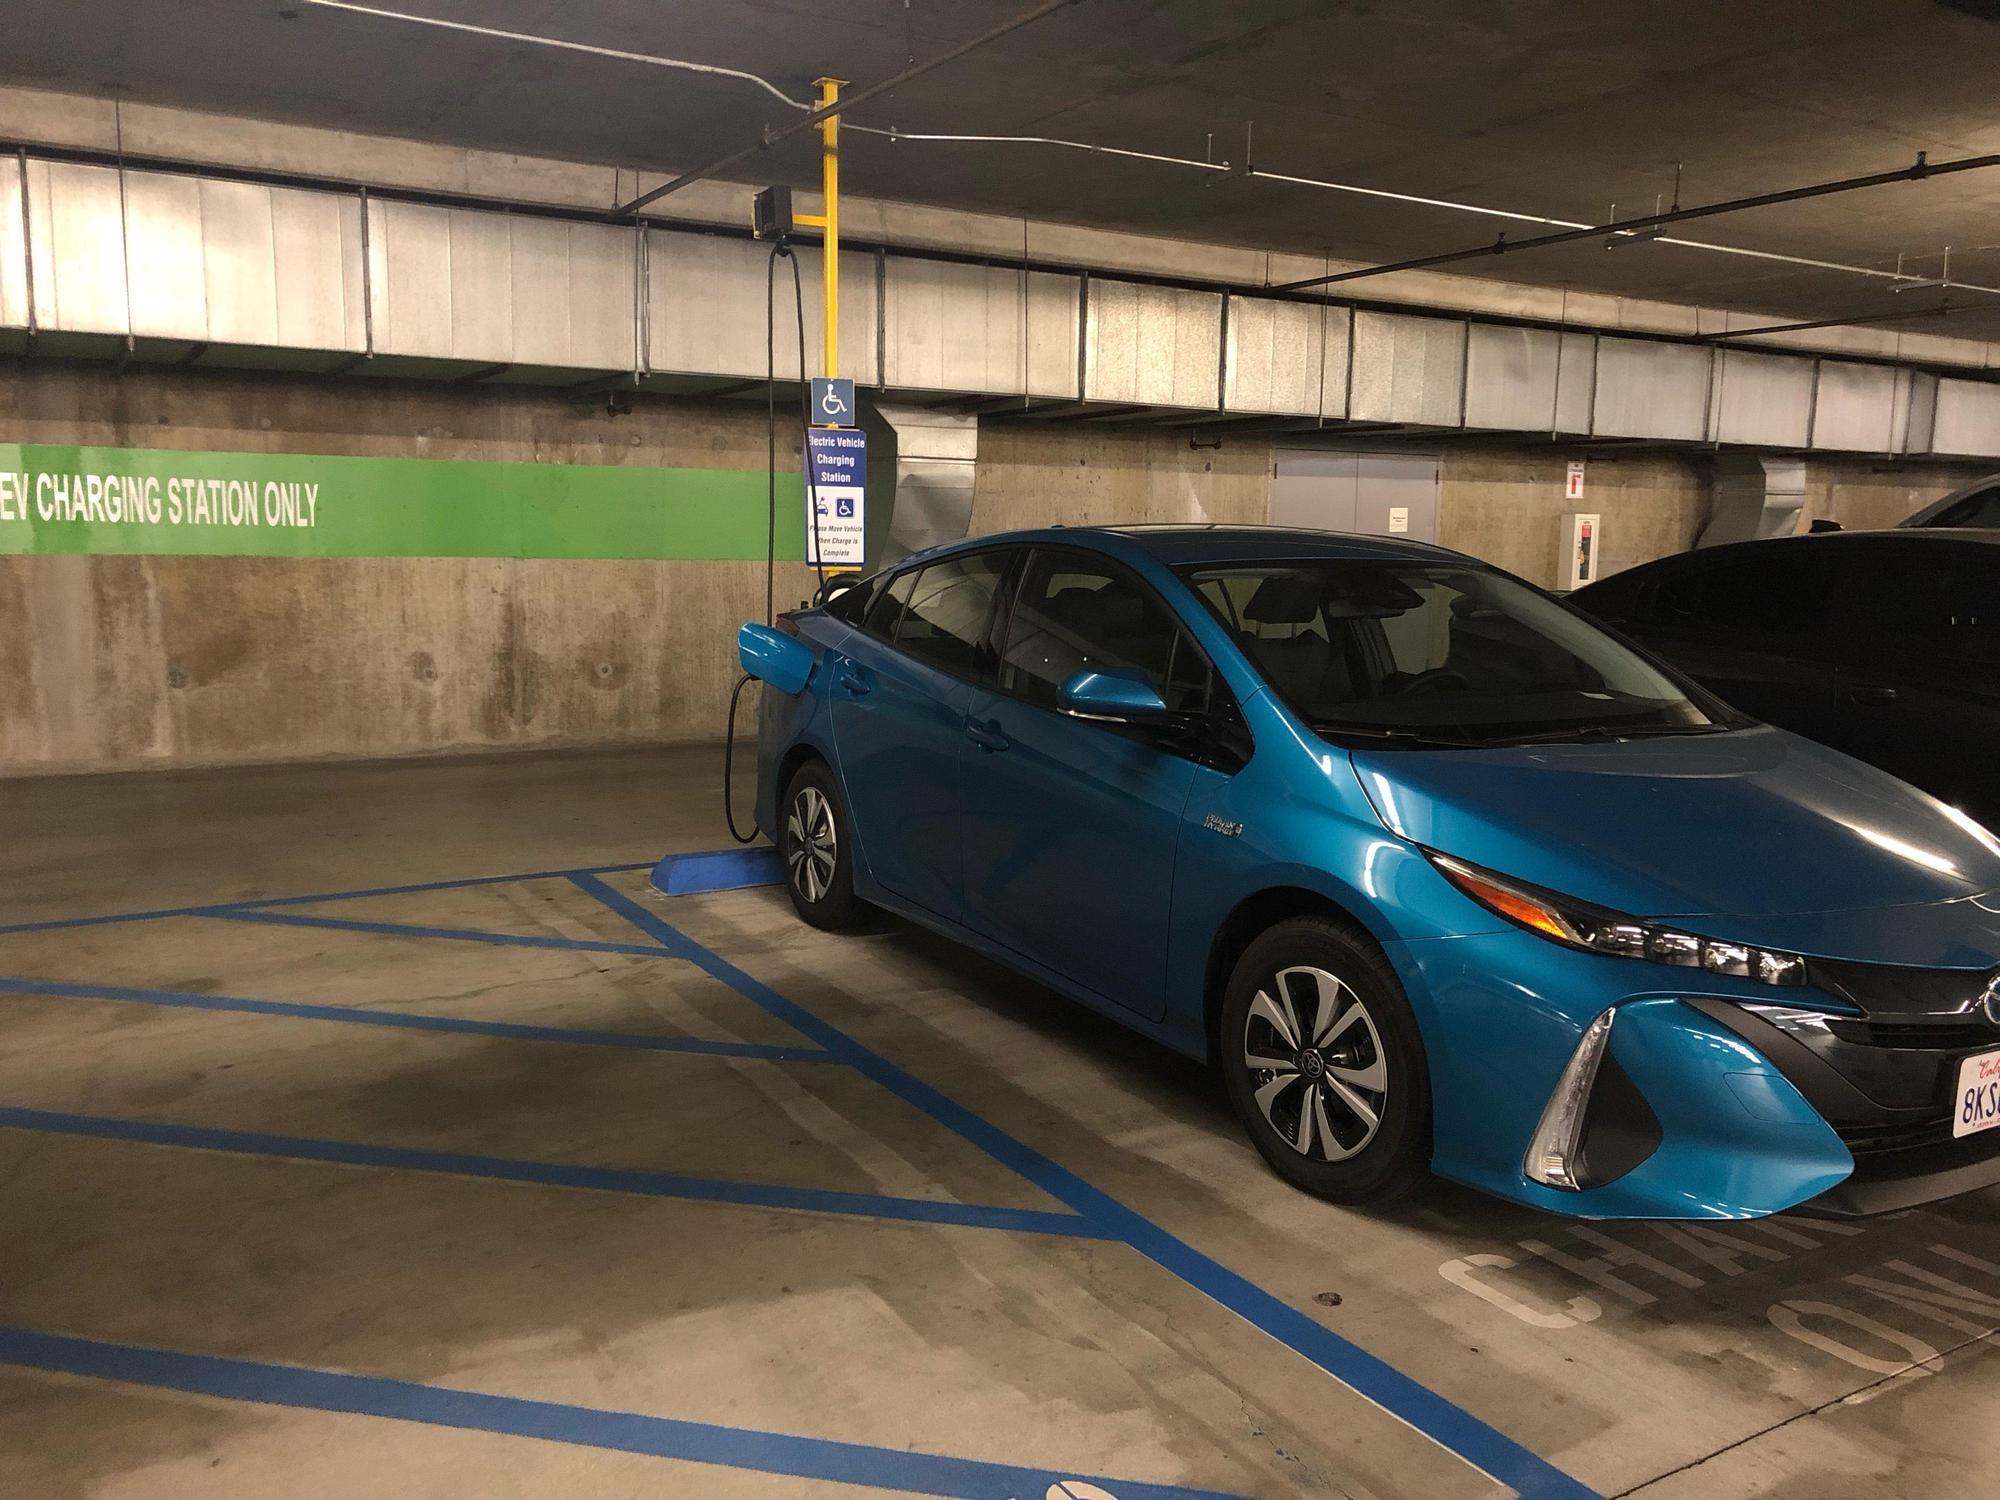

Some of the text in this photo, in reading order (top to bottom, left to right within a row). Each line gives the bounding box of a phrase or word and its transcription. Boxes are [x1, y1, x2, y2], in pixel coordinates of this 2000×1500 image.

[836, 437, 865, 449] Vehicle
[817, 453, 855, 467] Charging
[821, 471, 851, 483] Station
[0, 472, 319, 527] EV CHARGING STATION ONLY
[832, 537, 852, 546] Charge
[823, 549, 850, 557] Complete
[1963, 1081, 2000, 1124] 8KS
